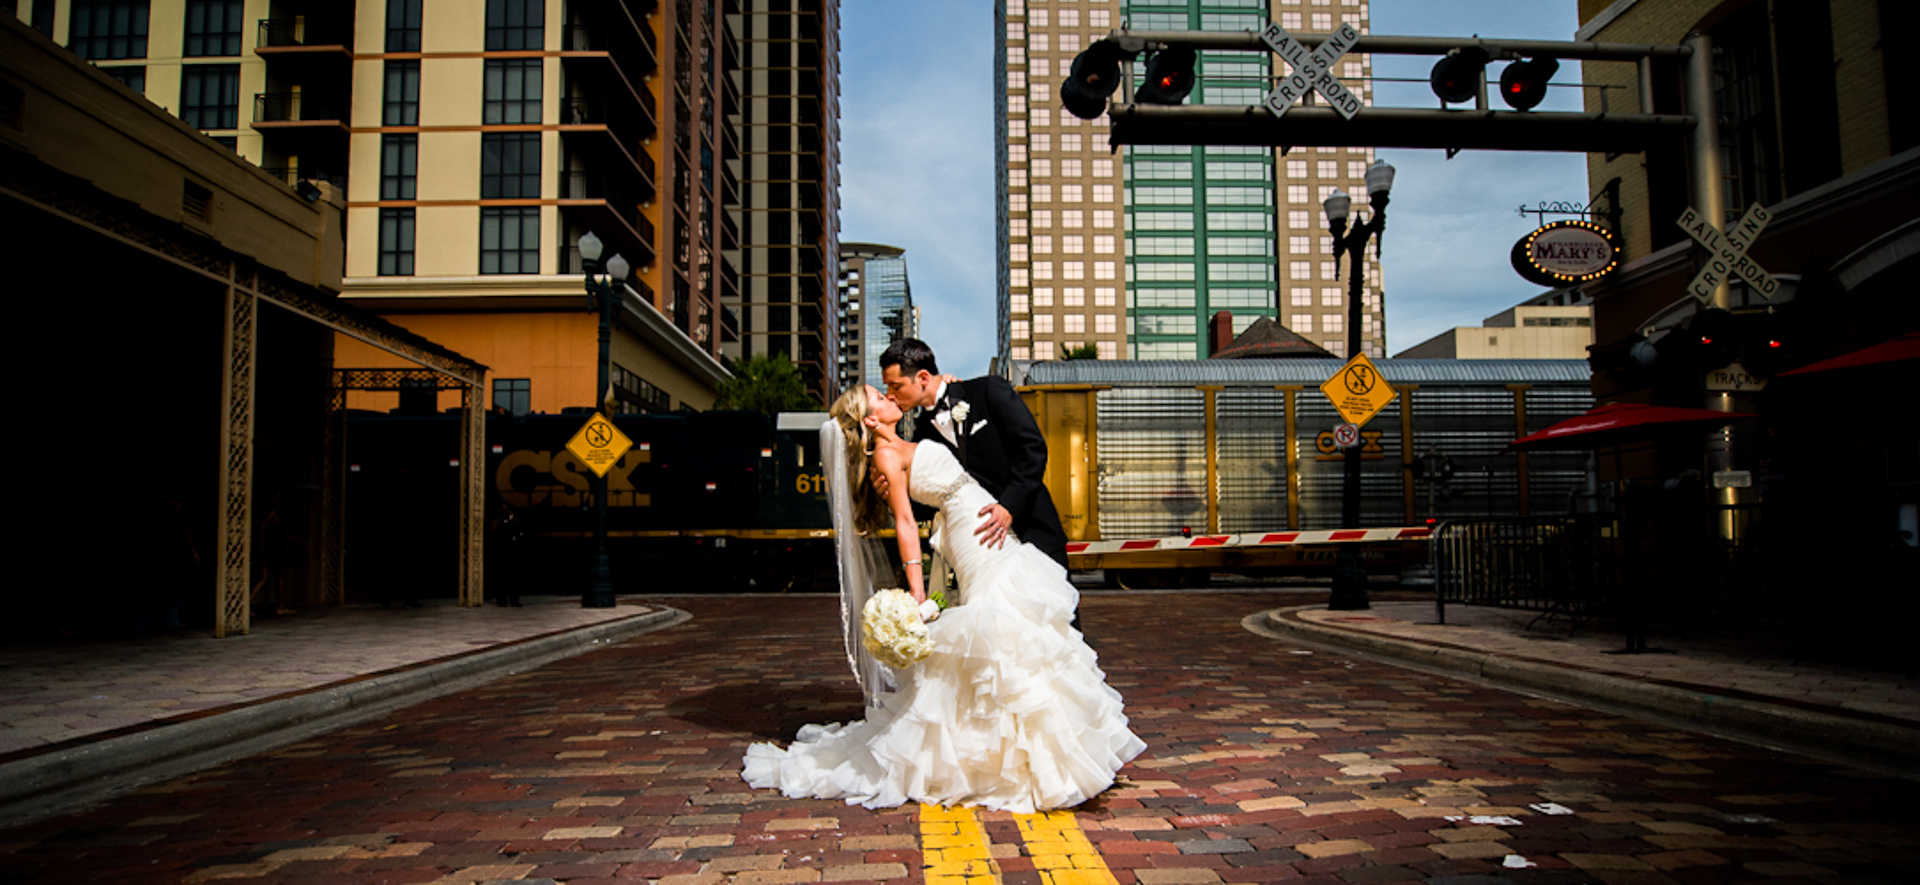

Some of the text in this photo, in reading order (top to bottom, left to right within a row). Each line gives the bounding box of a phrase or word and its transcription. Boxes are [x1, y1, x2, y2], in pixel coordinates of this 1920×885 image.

[1270, 27, 1356, 111] CROSSING
[1536, 242, 1606, 259] MARY'S
[1694, 207, 1768, 296] CROSSING
[1316, 430, 1383, 453] CX
